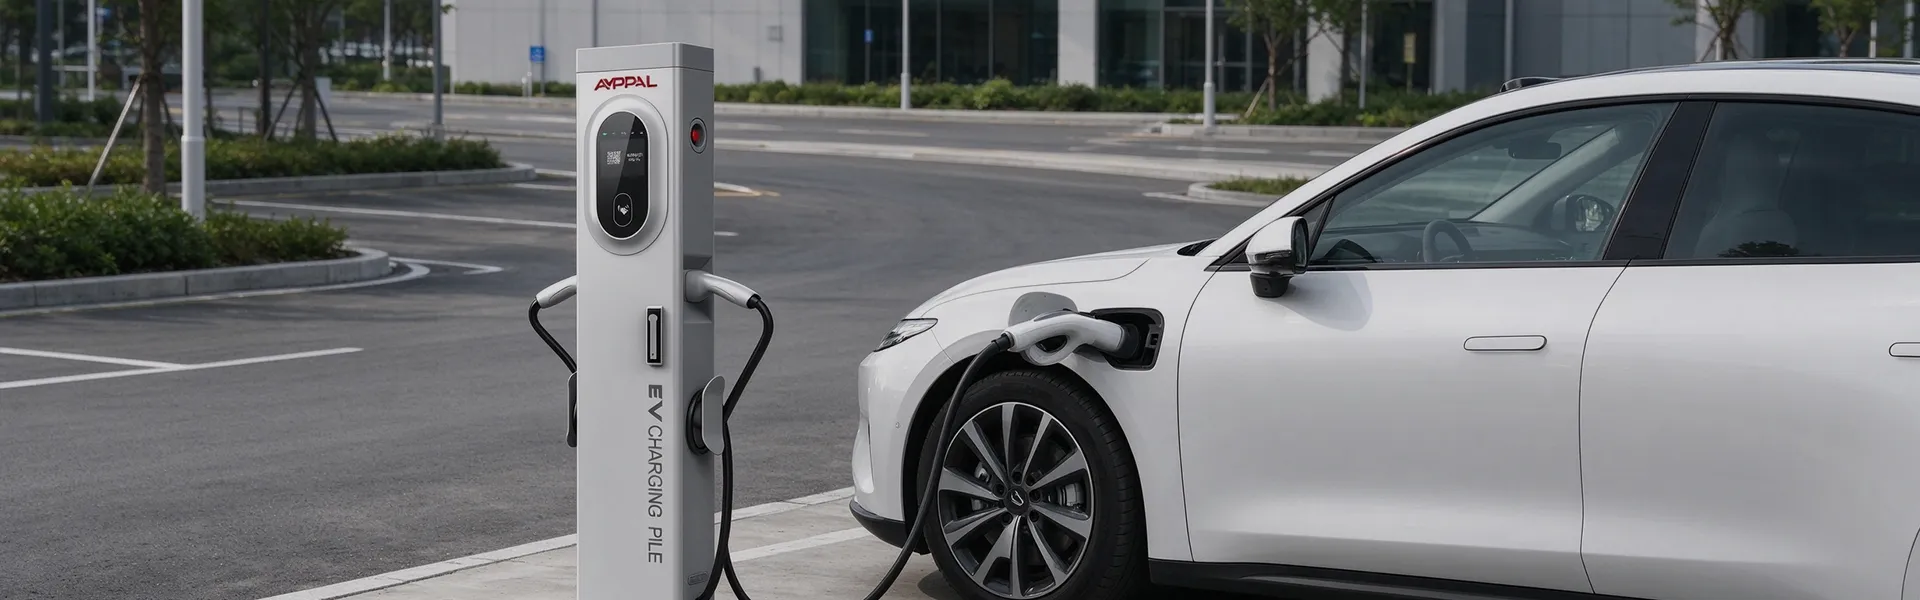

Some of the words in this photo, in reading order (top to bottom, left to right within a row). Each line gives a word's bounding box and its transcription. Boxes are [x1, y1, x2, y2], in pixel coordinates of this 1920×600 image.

[648, 384, 663, 422] EV
[648, 424, 663, 518] CHARGING
[648, 526, 663, 564] PILE
